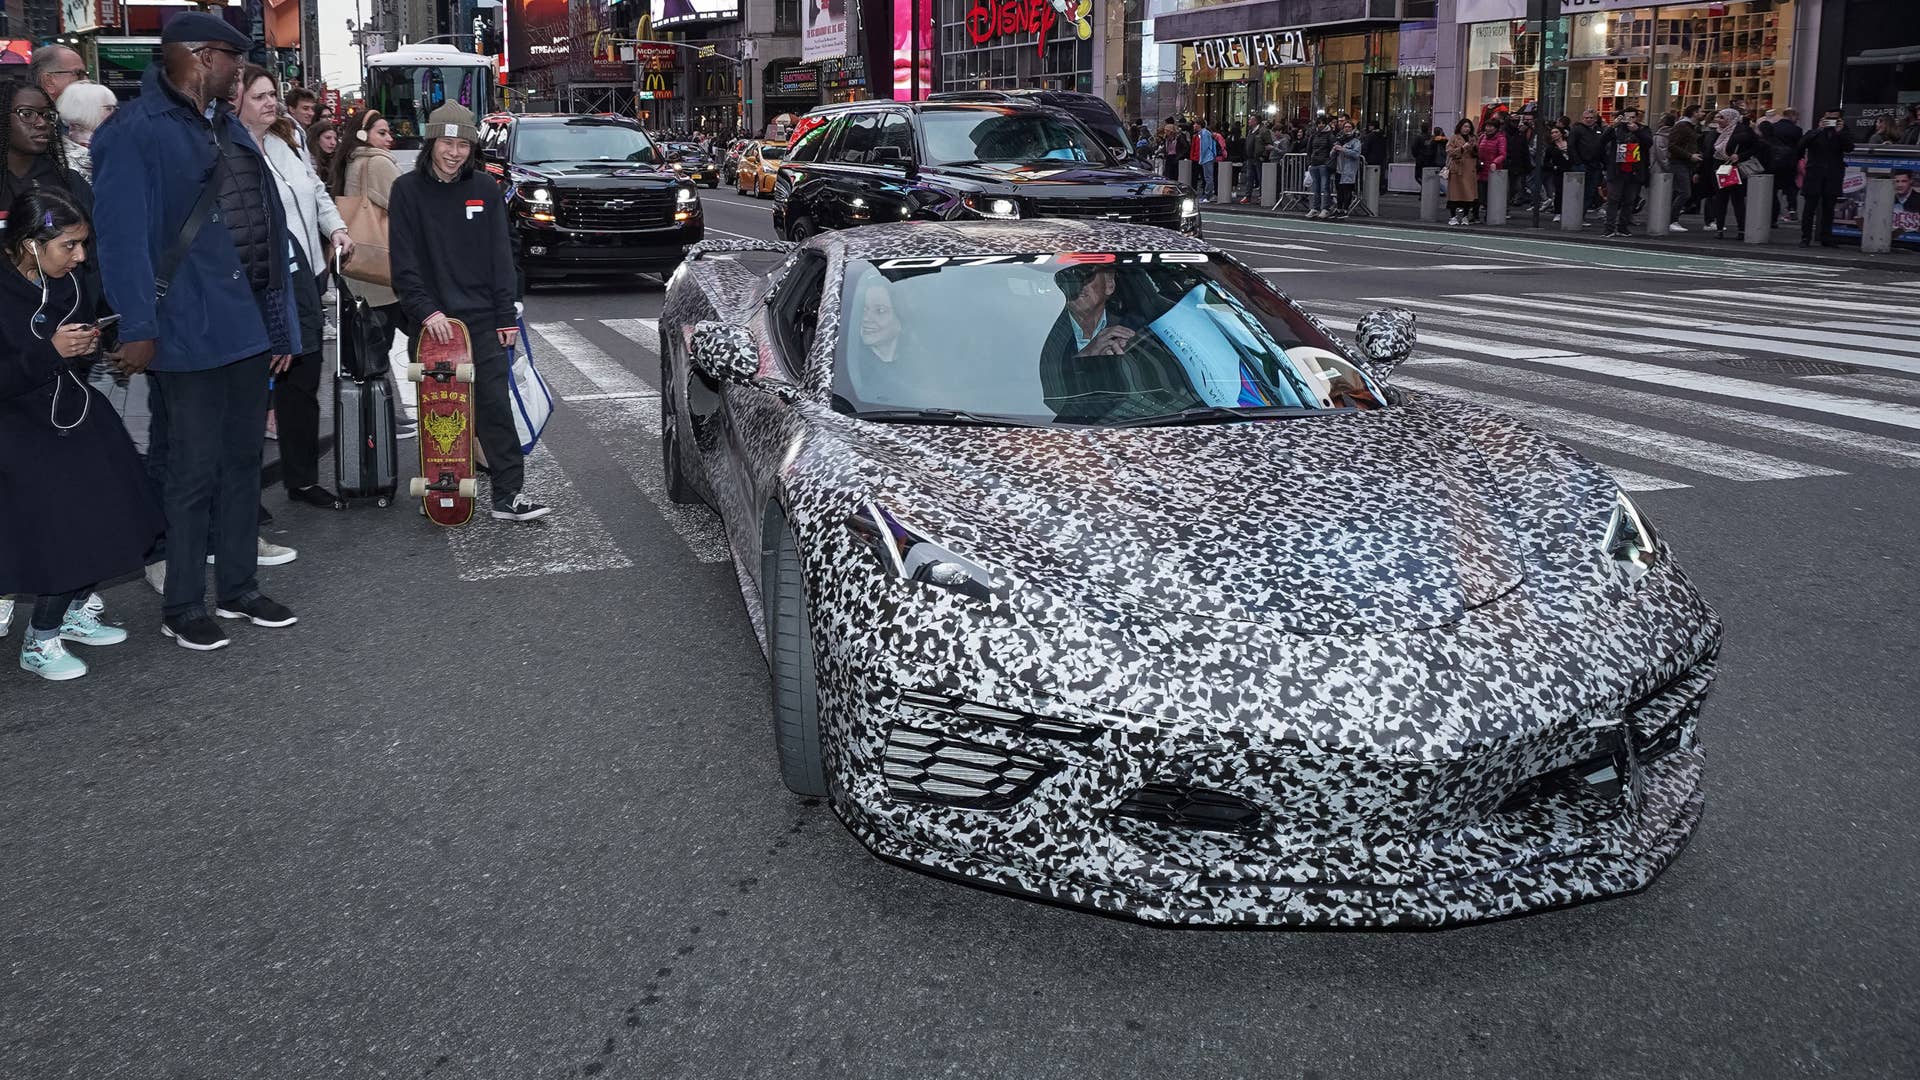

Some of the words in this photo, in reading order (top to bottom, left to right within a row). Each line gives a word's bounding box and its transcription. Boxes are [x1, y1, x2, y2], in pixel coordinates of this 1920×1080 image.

[1193, 34, 1281, 71] FOREVER
[1285, 30, 1306, 64] 21
[1862, 108, 1895, 117] ESCAPE
